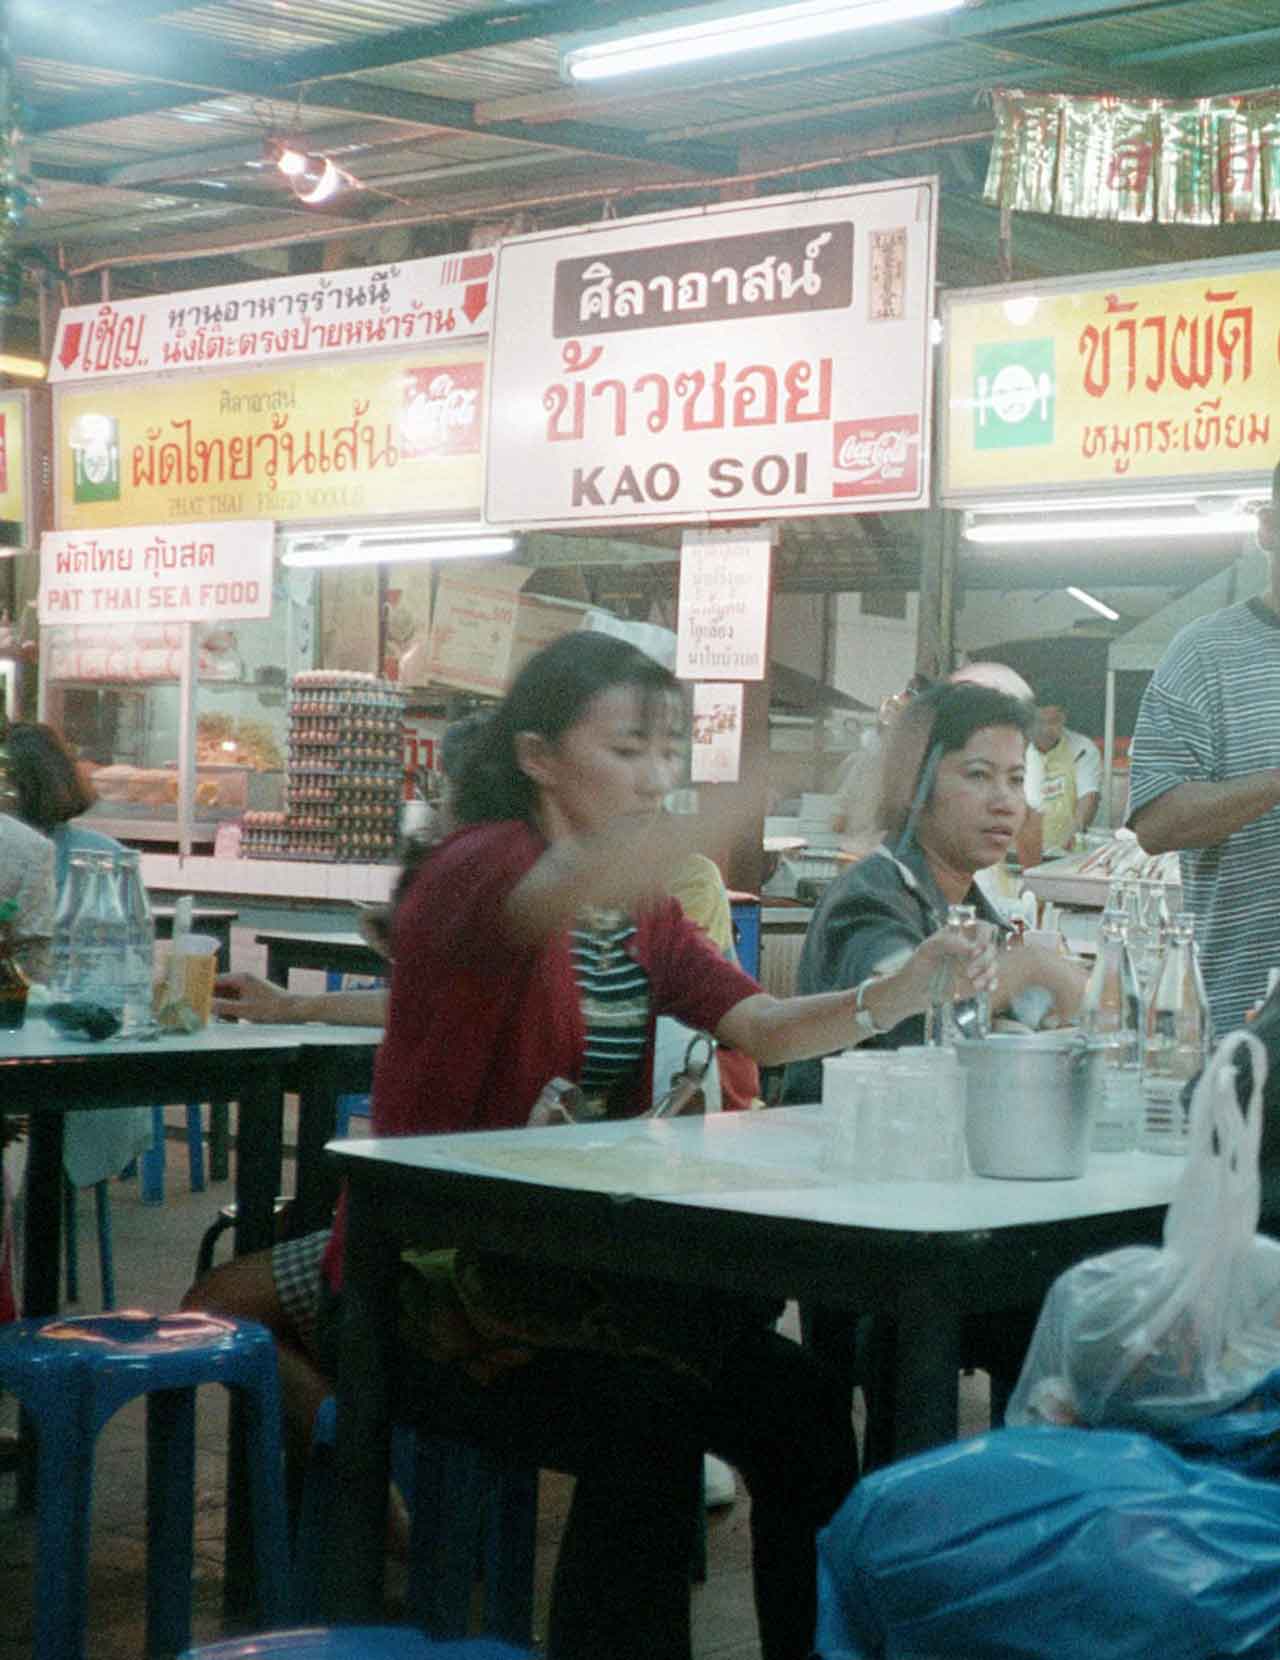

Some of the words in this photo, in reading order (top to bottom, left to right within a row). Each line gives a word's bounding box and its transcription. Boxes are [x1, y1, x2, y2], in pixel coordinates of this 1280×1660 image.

[168, 265, 401, 328] ทานอาหารร้านนี้
[578, 231, 832, 322] ศิลาอาสน์
[1079, 287, 1253, 399] ข้าวผัด
[543, 339, 833, 442] ข้าวซอย
[130, 398, 400, 492] ผัดไทยวุ้นเส้น
[1080, 396, 1271, 475] หมูกระเทียม
[570, 462, 681, 508] KAO
[708, 451, 809, 499] SOI
[47, 588, 83, 612] PAT
[93, 586, 142, 611] THAI
[148, 584, 192, 609] SEA
[200, 580, 260, 607] FOOD
[55, 540, 133, 576] ผัดไทย
